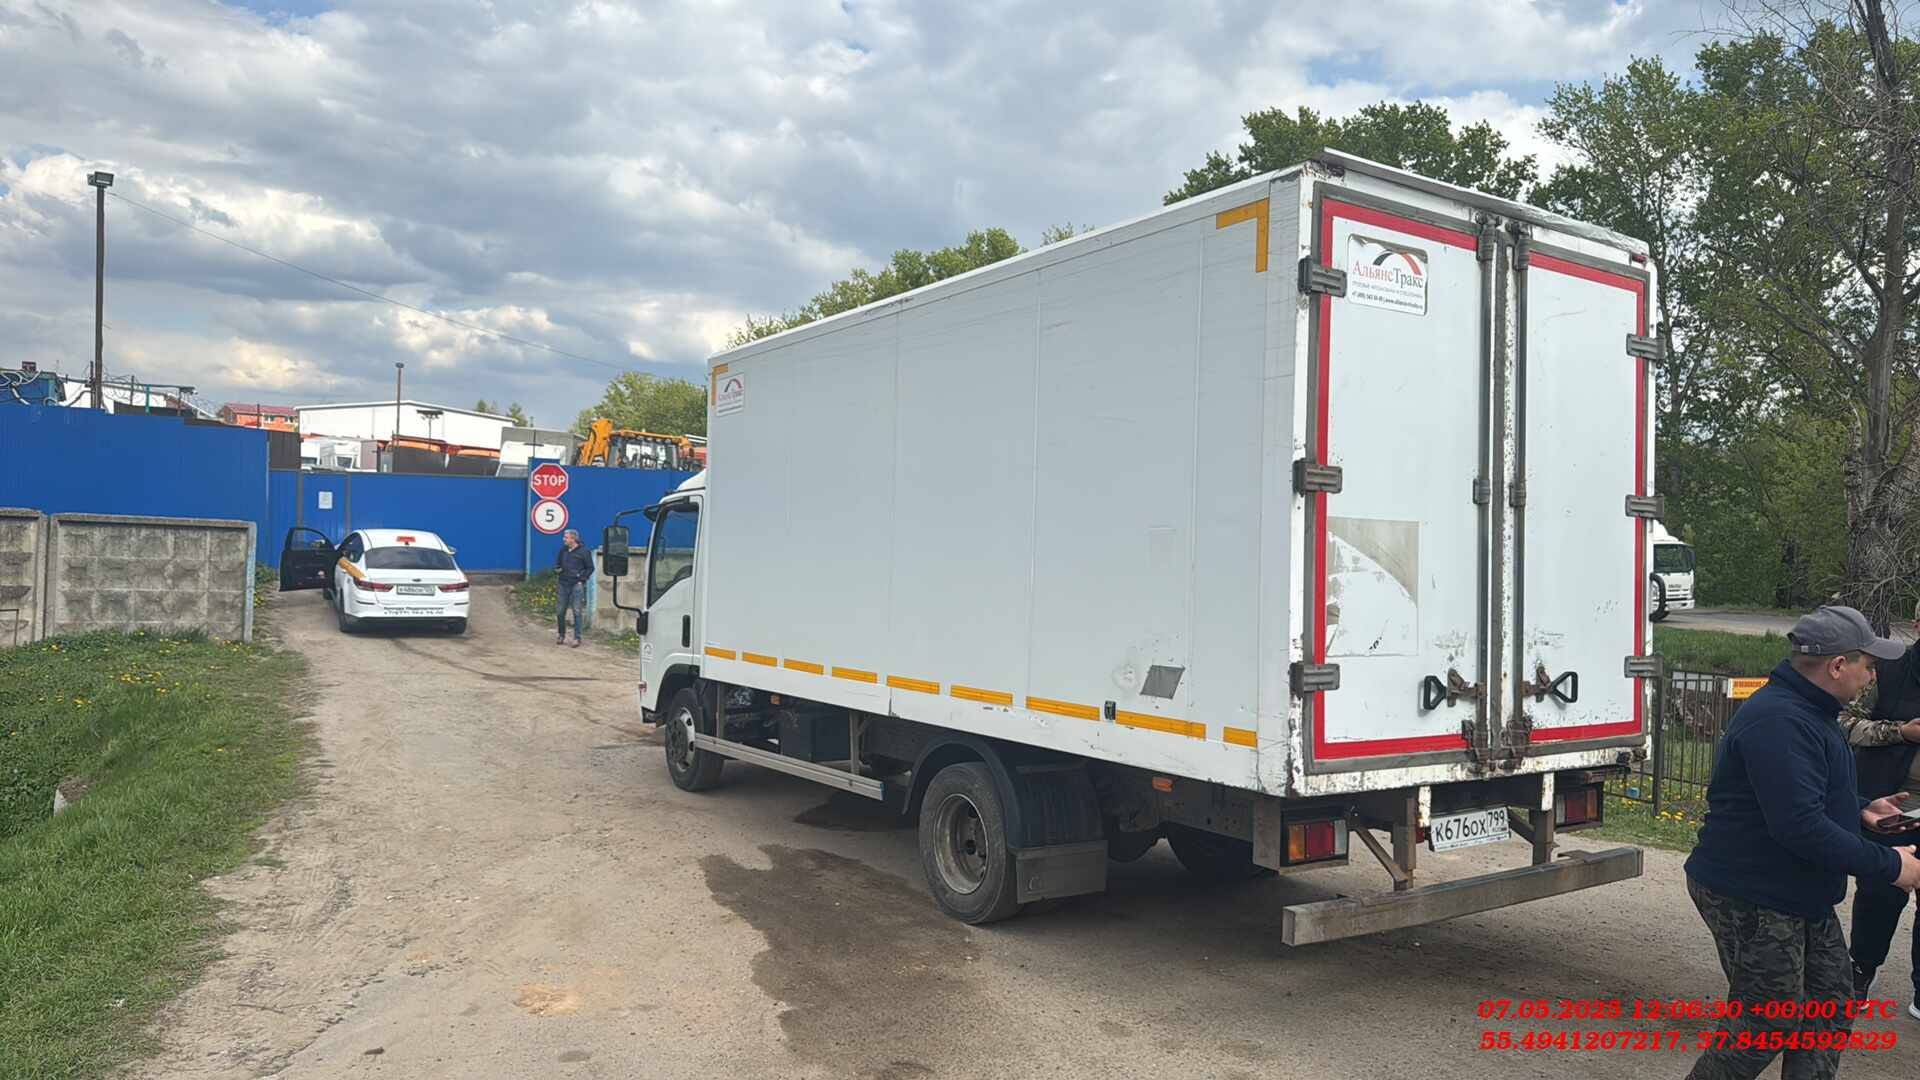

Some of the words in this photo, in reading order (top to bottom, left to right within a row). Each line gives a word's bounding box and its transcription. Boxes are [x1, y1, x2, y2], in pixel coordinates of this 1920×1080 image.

[1353, 260, 1423, 289] АльянсТракс
[534, 474, 566, 487] STOP
[545, 509, 555, 523] 5
[1487, 809, 1505, 827] 799
